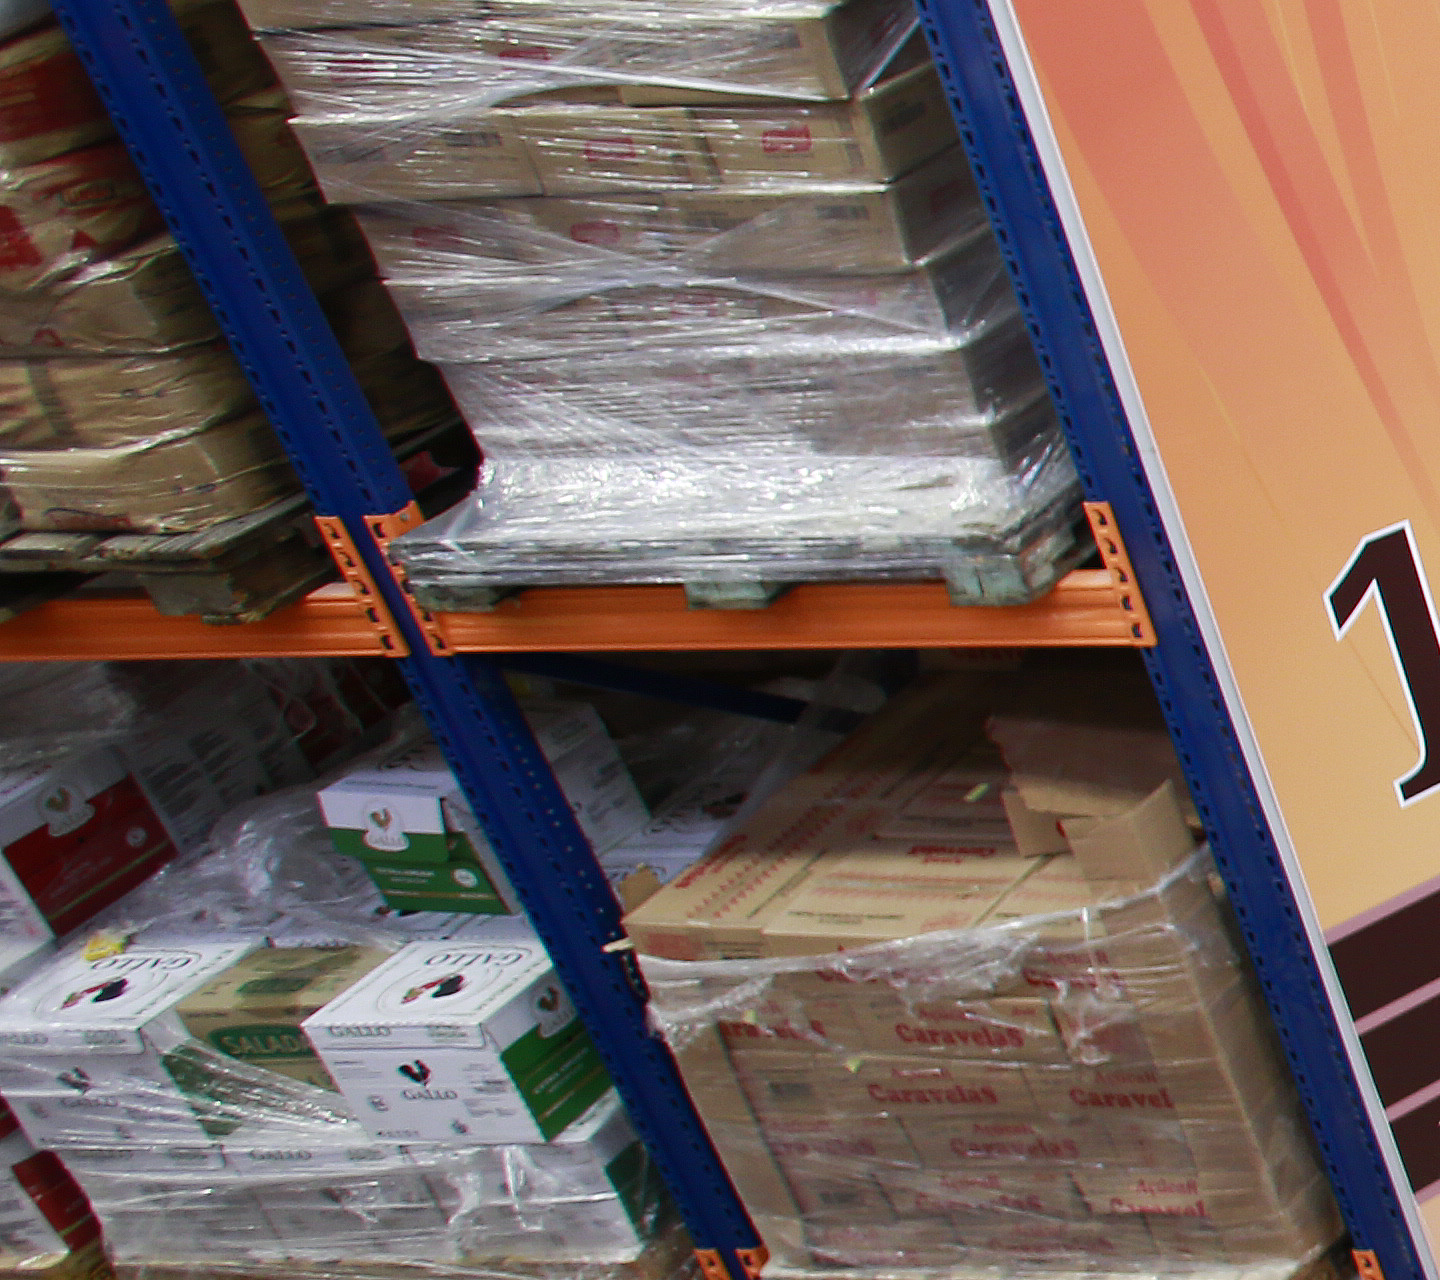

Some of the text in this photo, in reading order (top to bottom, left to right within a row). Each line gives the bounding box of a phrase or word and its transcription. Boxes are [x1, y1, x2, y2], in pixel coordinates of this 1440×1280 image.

[422, 951, 527, 970] GALLO
[323, 1024, 391, 1039] GALLO
[400, 1087, 459, 1102] GALLO
